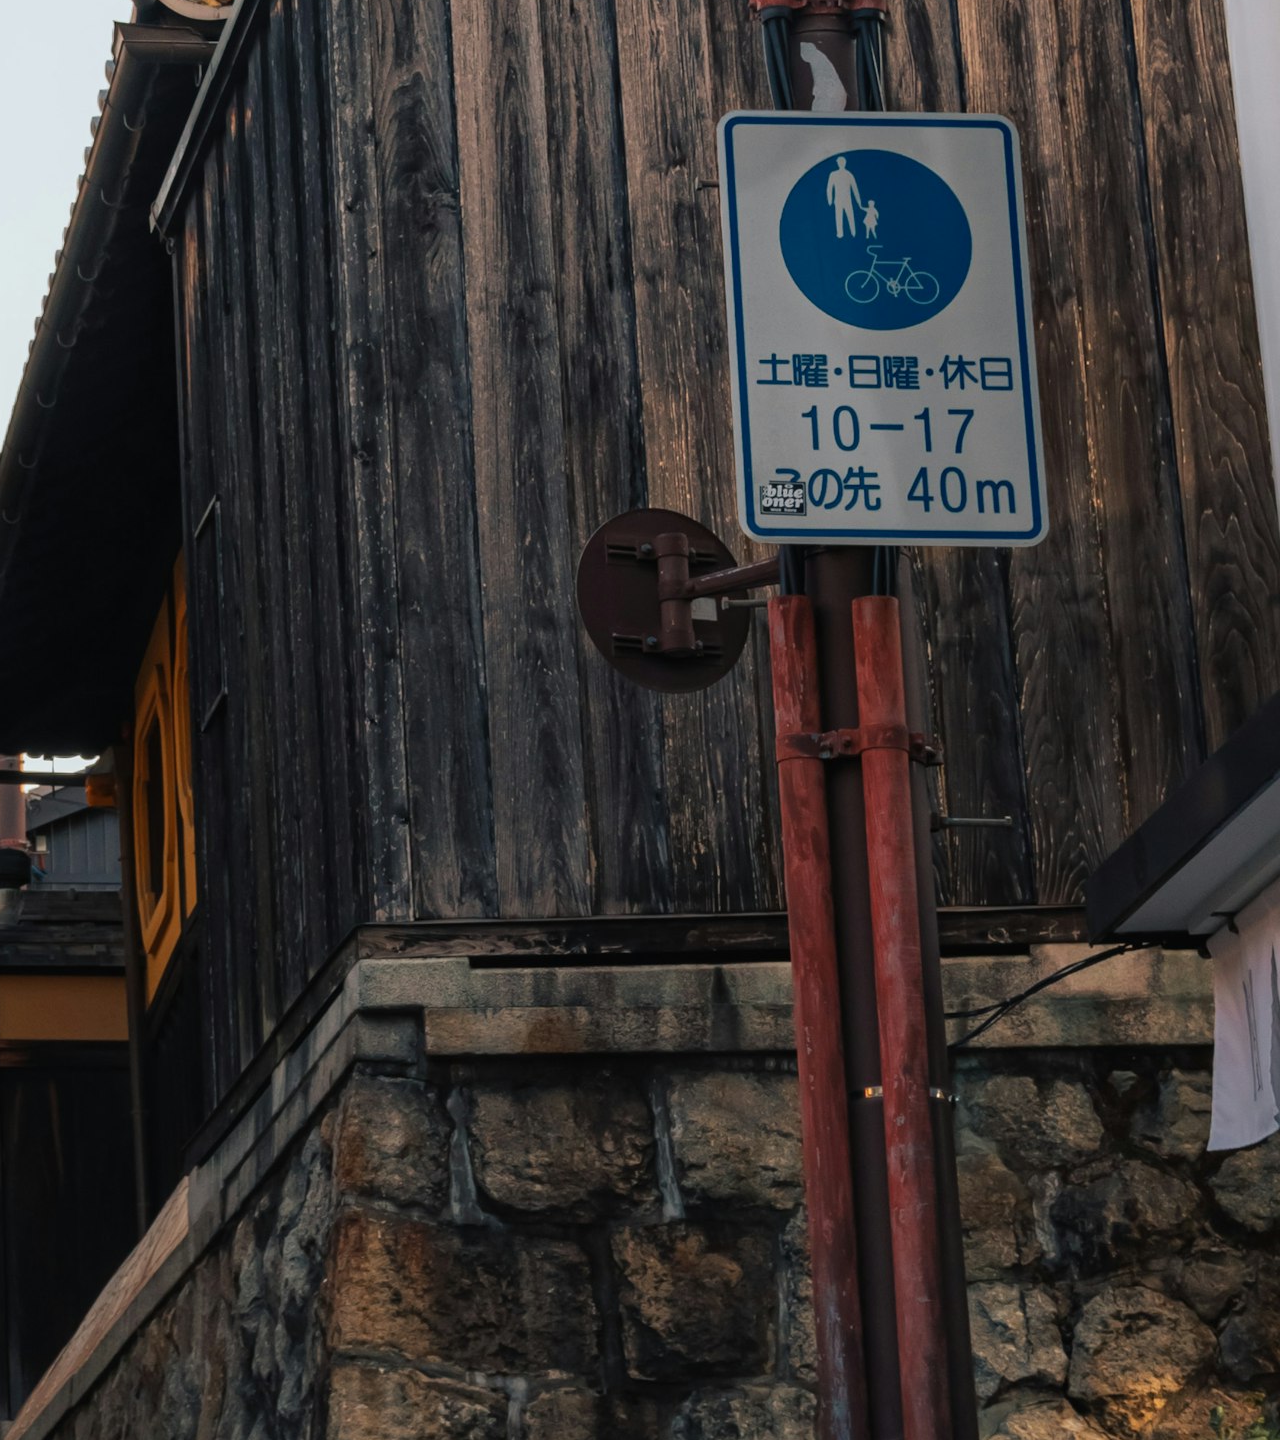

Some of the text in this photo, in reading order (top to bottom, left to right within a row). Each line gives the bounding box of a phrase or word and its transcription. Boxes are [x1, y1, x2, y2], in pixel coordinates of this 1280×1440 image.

[756, 353, 1014, 391] 土曜・日曜・休日
[801, 404, 975, 455] 10-17
[761, 497, 804, 508] oner
[907, 466, 1017, 514] 40m
